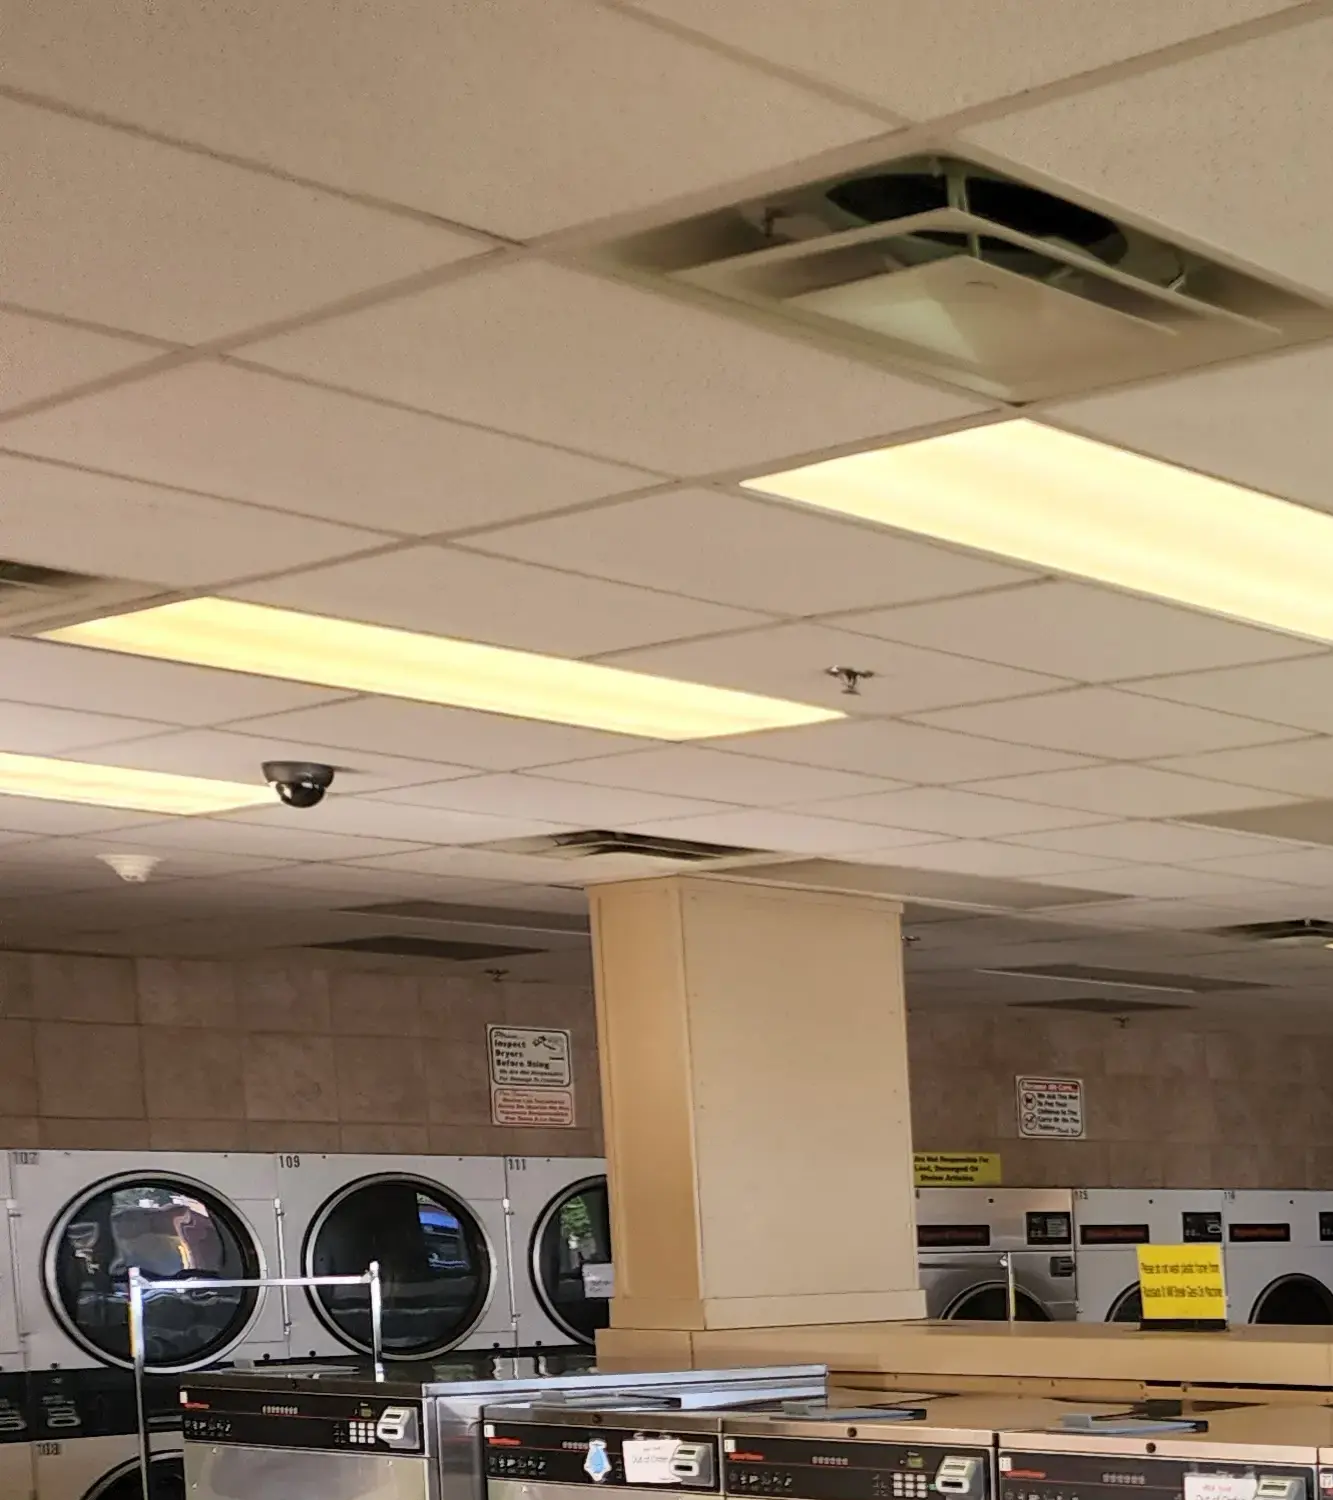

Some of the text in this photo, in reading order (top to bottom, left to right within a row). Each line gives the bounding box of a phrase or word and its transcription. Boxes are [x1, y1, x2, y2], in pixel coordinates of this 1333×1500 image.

[494, 1040, 526, 1048] Inspect
[495, 1049, 523, 1058] Dryers
[496, 1059, 524, 1067] Before
[279, 1155, 301, 1169] 109
[508, 1158, 527, 1171] 111
